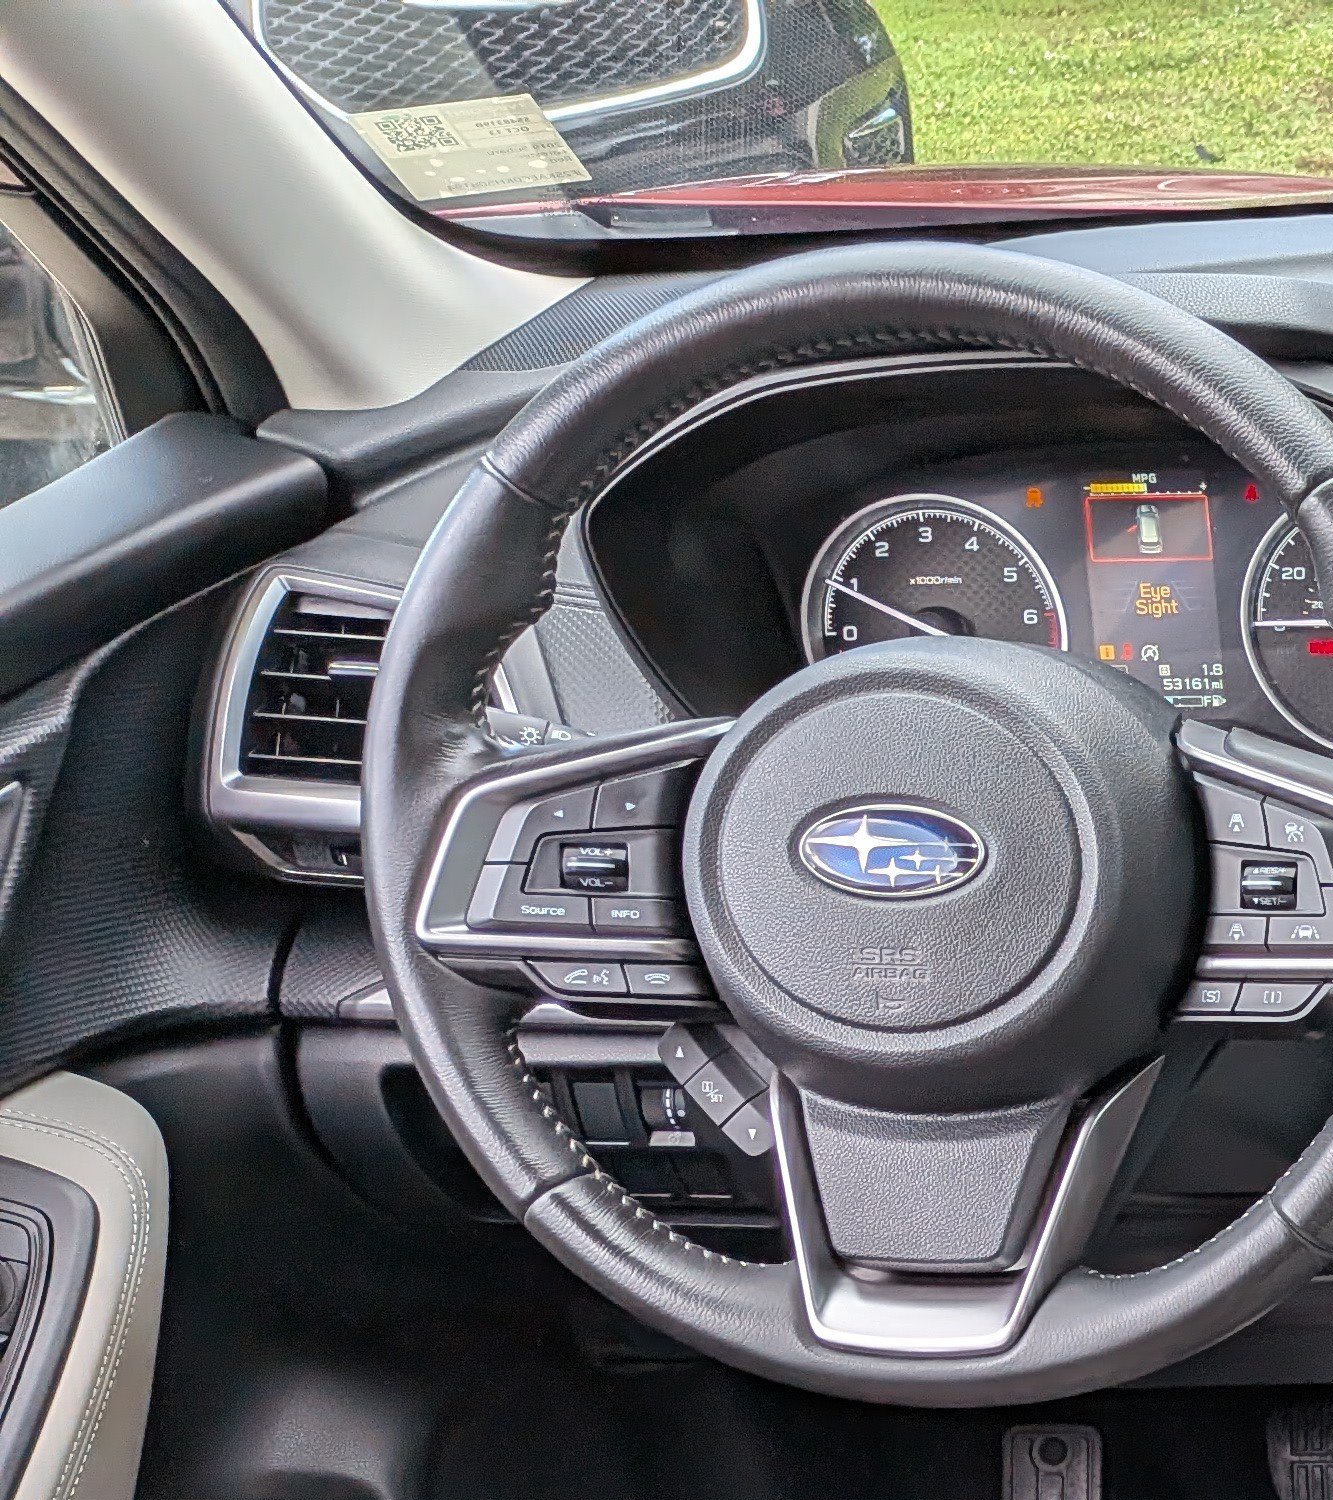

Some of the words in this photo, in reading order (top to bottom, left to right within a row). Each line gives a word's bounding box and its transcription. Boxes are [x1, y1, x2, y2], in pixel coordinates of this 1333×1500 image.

[1132, 474, 1157, 483] MPG
[918, 527, 932, 542] 3
[875, 542, 889, 557] 2
[965, 537, 979, 552] 4
[1004, 568, 1018, 582] 5
[1282, 567, 1305, 580] 20
[850, 578, 858, 592] 1
[1140, 583, 1171, 601] Eye
[1137, 600, 1179, 618] Sight
[1023, 609, 1038, 624] 6
[843, 625, 857, 642] 0
[1202, 664, 1223, 676] 1.8
[1204, 695, 1212, 705] F
[521, 905, 566, 916] Source
[611, 910, 640, 919] INFO
[860, 946, 920, 962] SRS
[852, 967, 928, 979] AIRBAG
